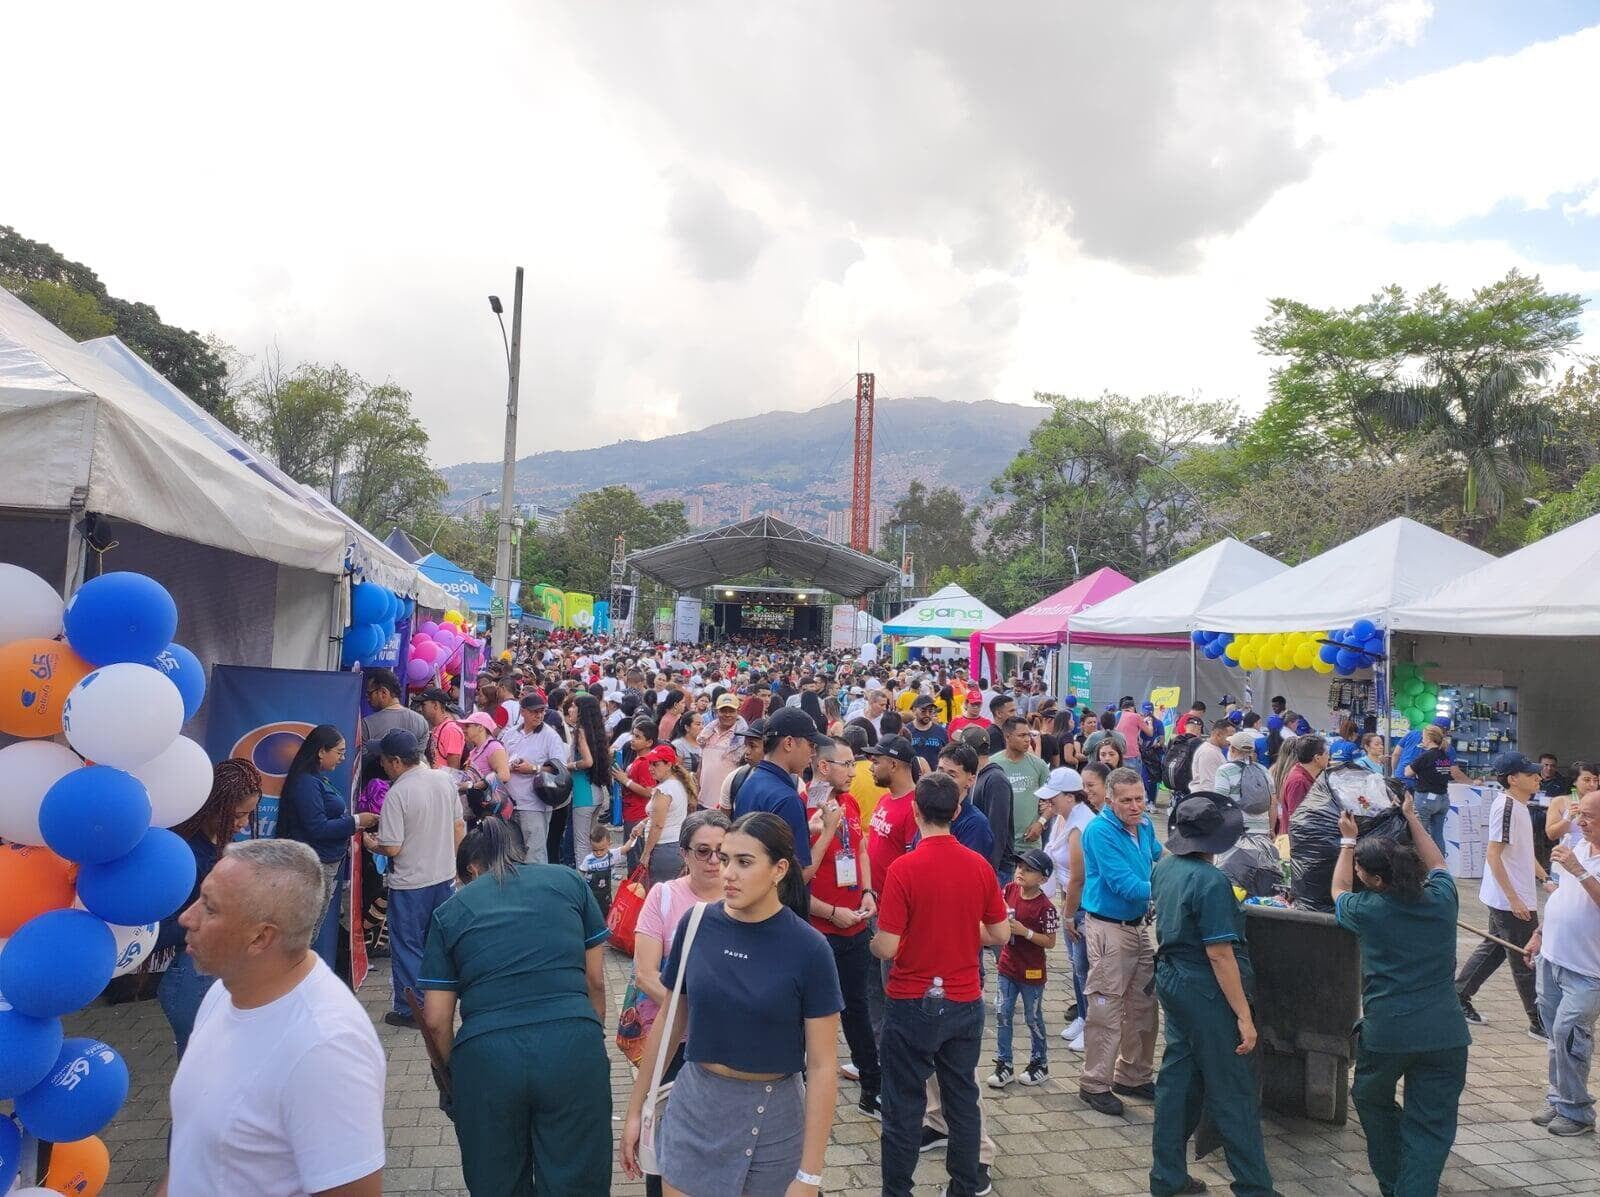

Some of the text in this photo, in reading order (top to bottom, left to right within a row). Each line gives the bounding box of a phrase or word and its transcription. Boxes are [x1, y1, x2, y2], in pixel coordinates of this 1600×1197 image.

[440, 580, 479, 595] OBÓN
[918, 608, 983, 621] gana
[30, 653, 52, 680] 65
[724, 949, 748, 959] PAUSA
[61, 1056, 89, 1091] 65
